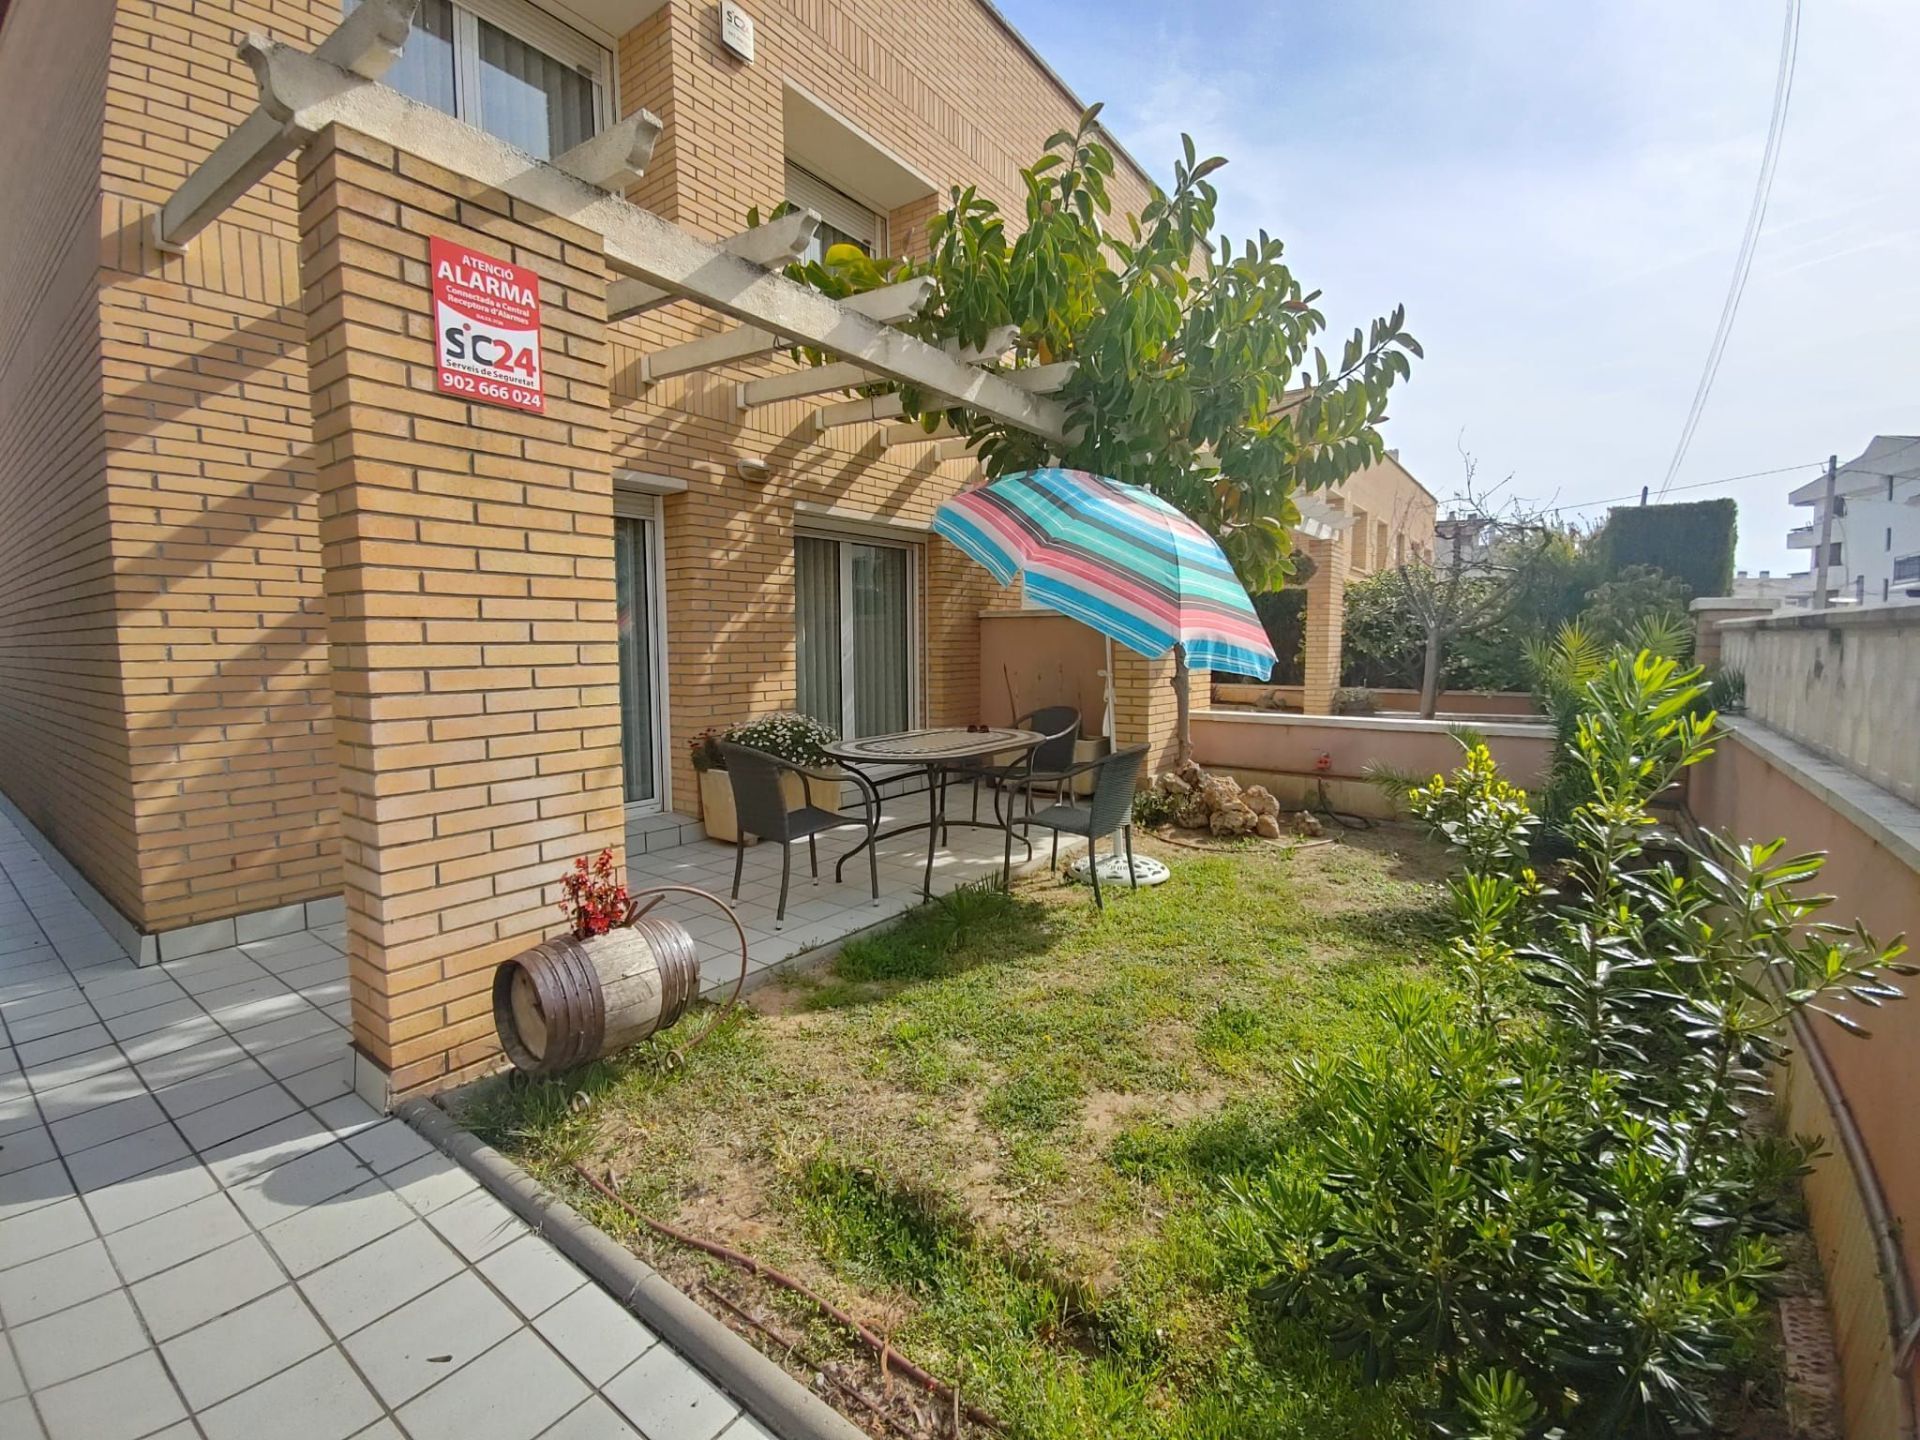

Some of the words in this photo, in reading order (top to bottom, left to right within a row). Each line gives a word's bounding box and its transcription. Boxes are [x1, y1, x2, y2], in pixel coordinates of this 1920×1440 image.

[462, 255, 514, 281] ATENCIÓ
[438, 261, 537, 309] ALARMA
[448, 294, 489, 314] Receptora
[502, 302, 530, 318] Central
[446, 359, 479, 375] Serveis
[480, 368, 492, 377] de
[493, 370, 534, 388] Seguretat
[442, 373, 475, 392] 902
[479, 382, 509, 400] 666
[512, 391, 541, 408] 024
